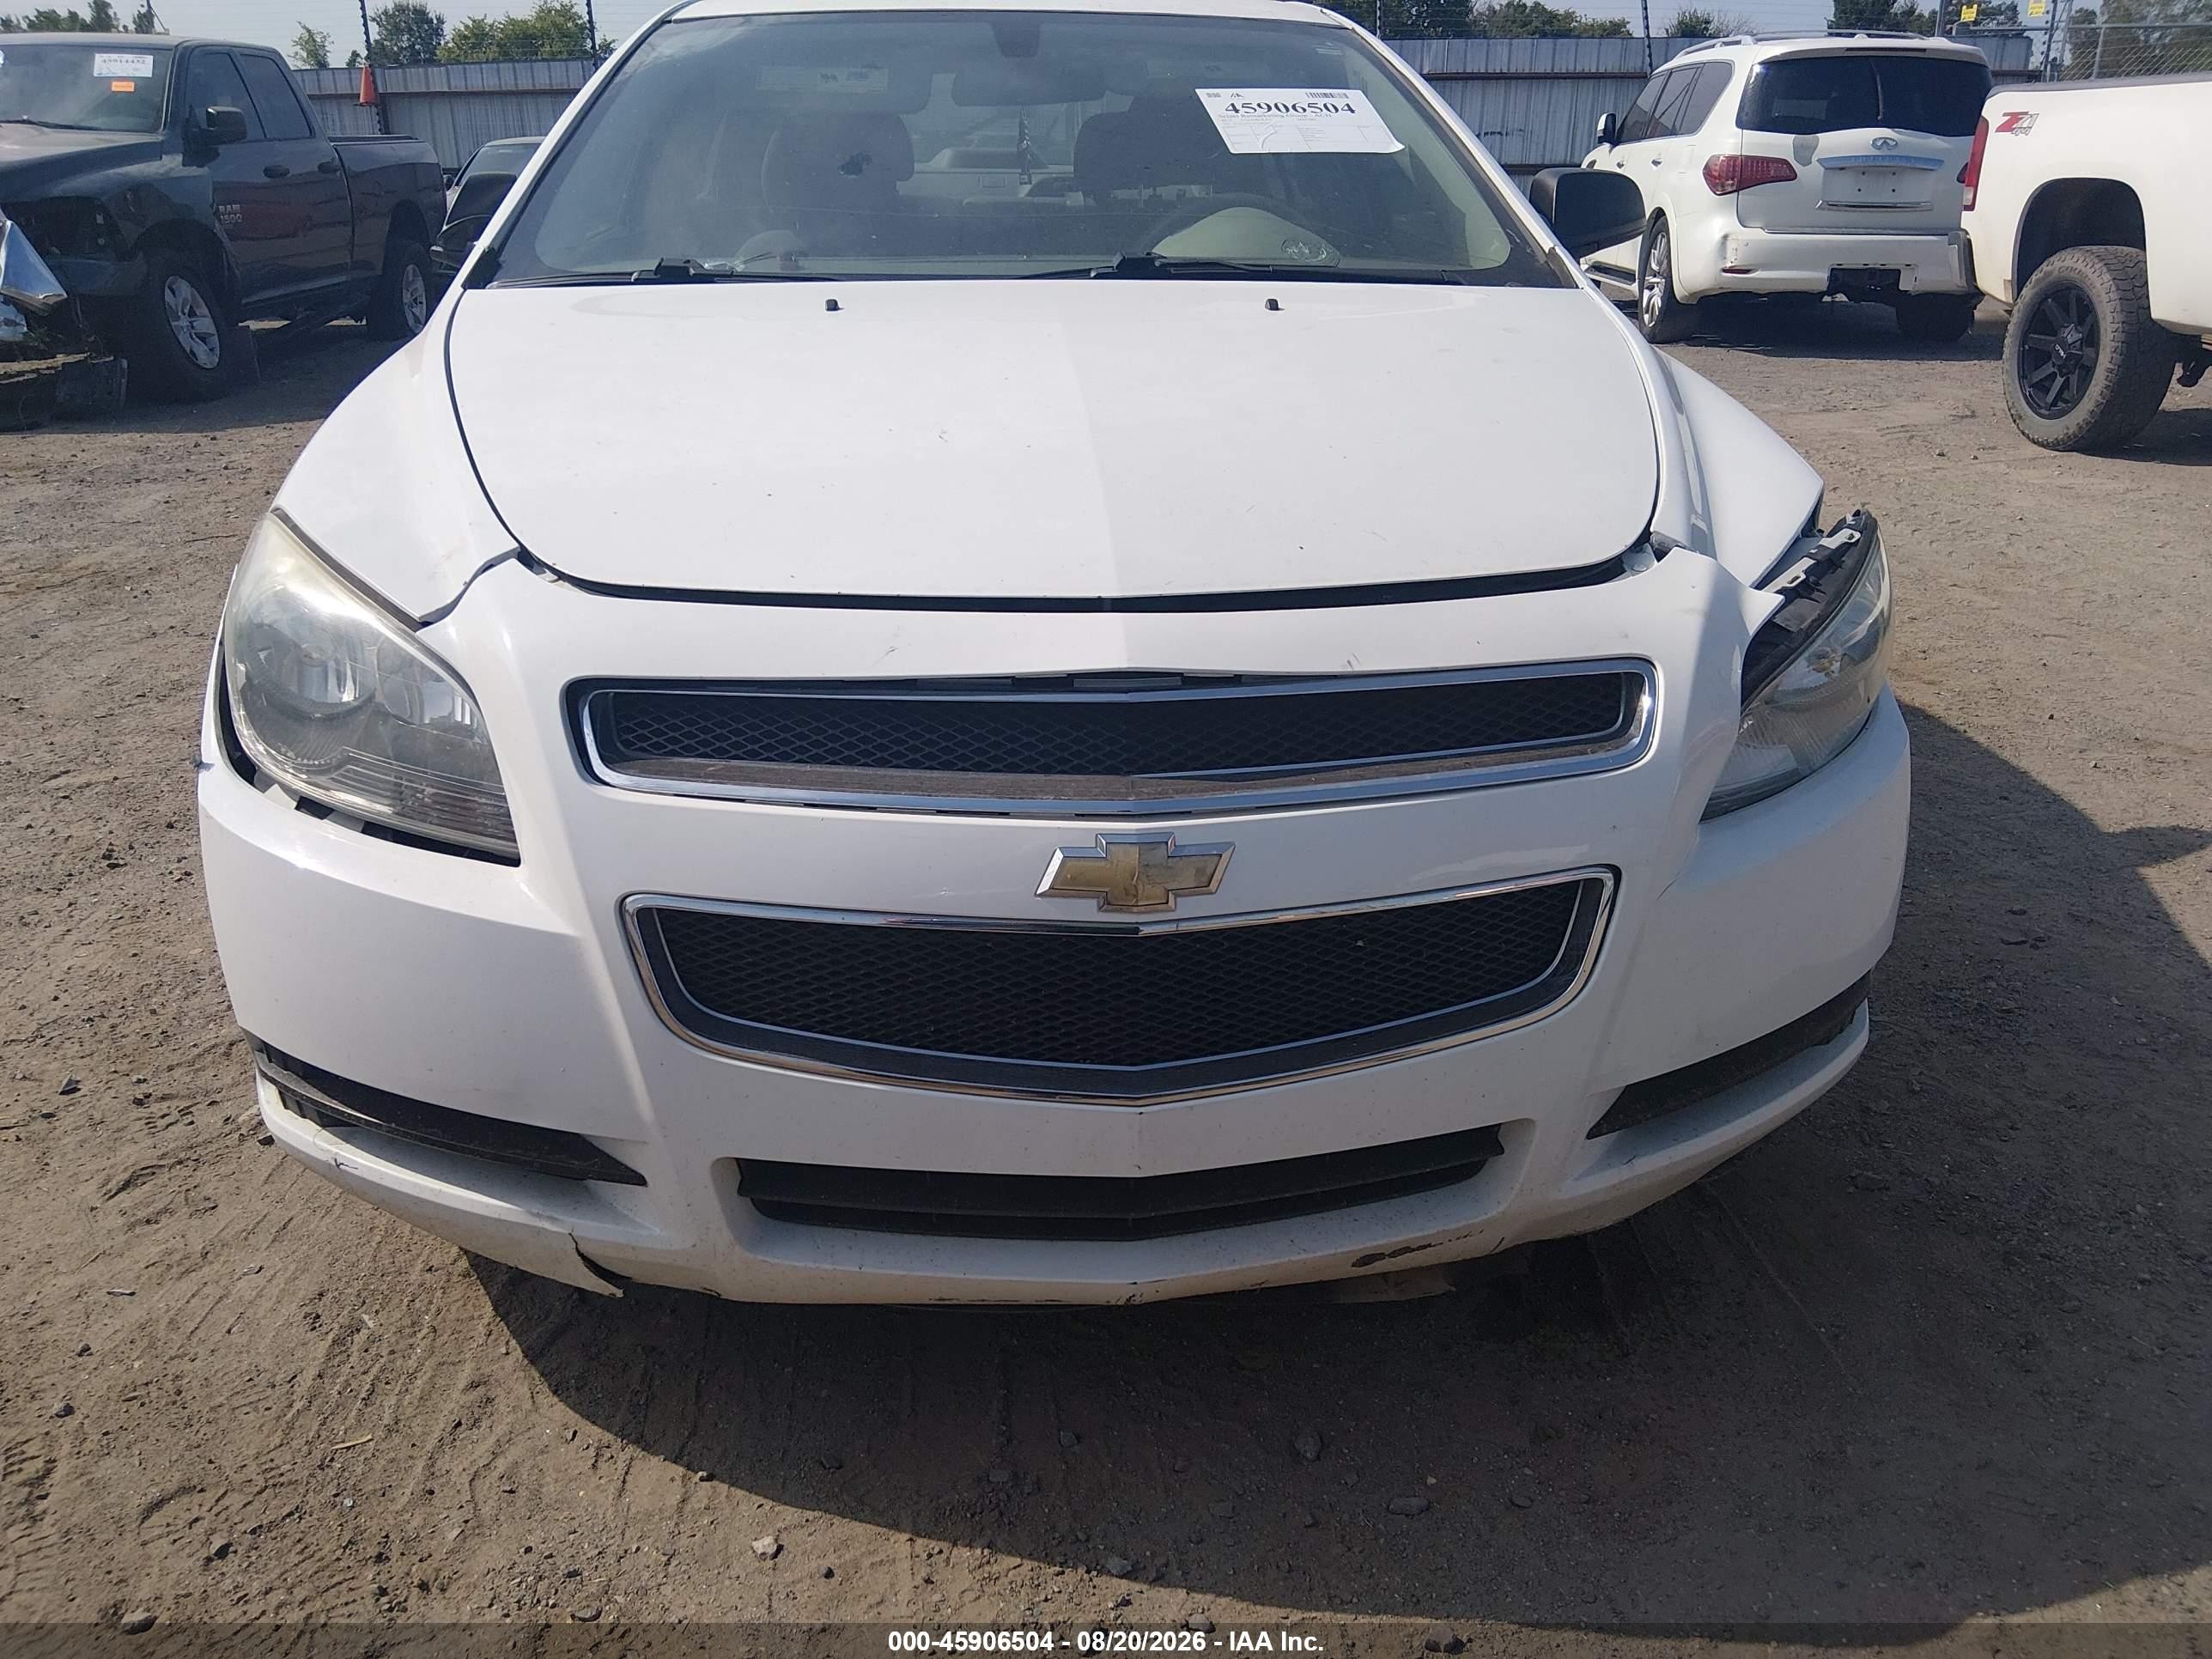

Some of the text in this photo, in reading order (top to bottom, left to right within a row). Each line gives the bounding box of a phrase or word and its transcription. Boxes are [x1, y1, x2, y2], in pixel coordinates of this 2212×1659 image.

[1225, 102, 1356, 113] 45906504
[1995, 112, 2039, 133] Z71
[219, 204, 241, 215] RAM
[220, 214, 242, 223] 1500
